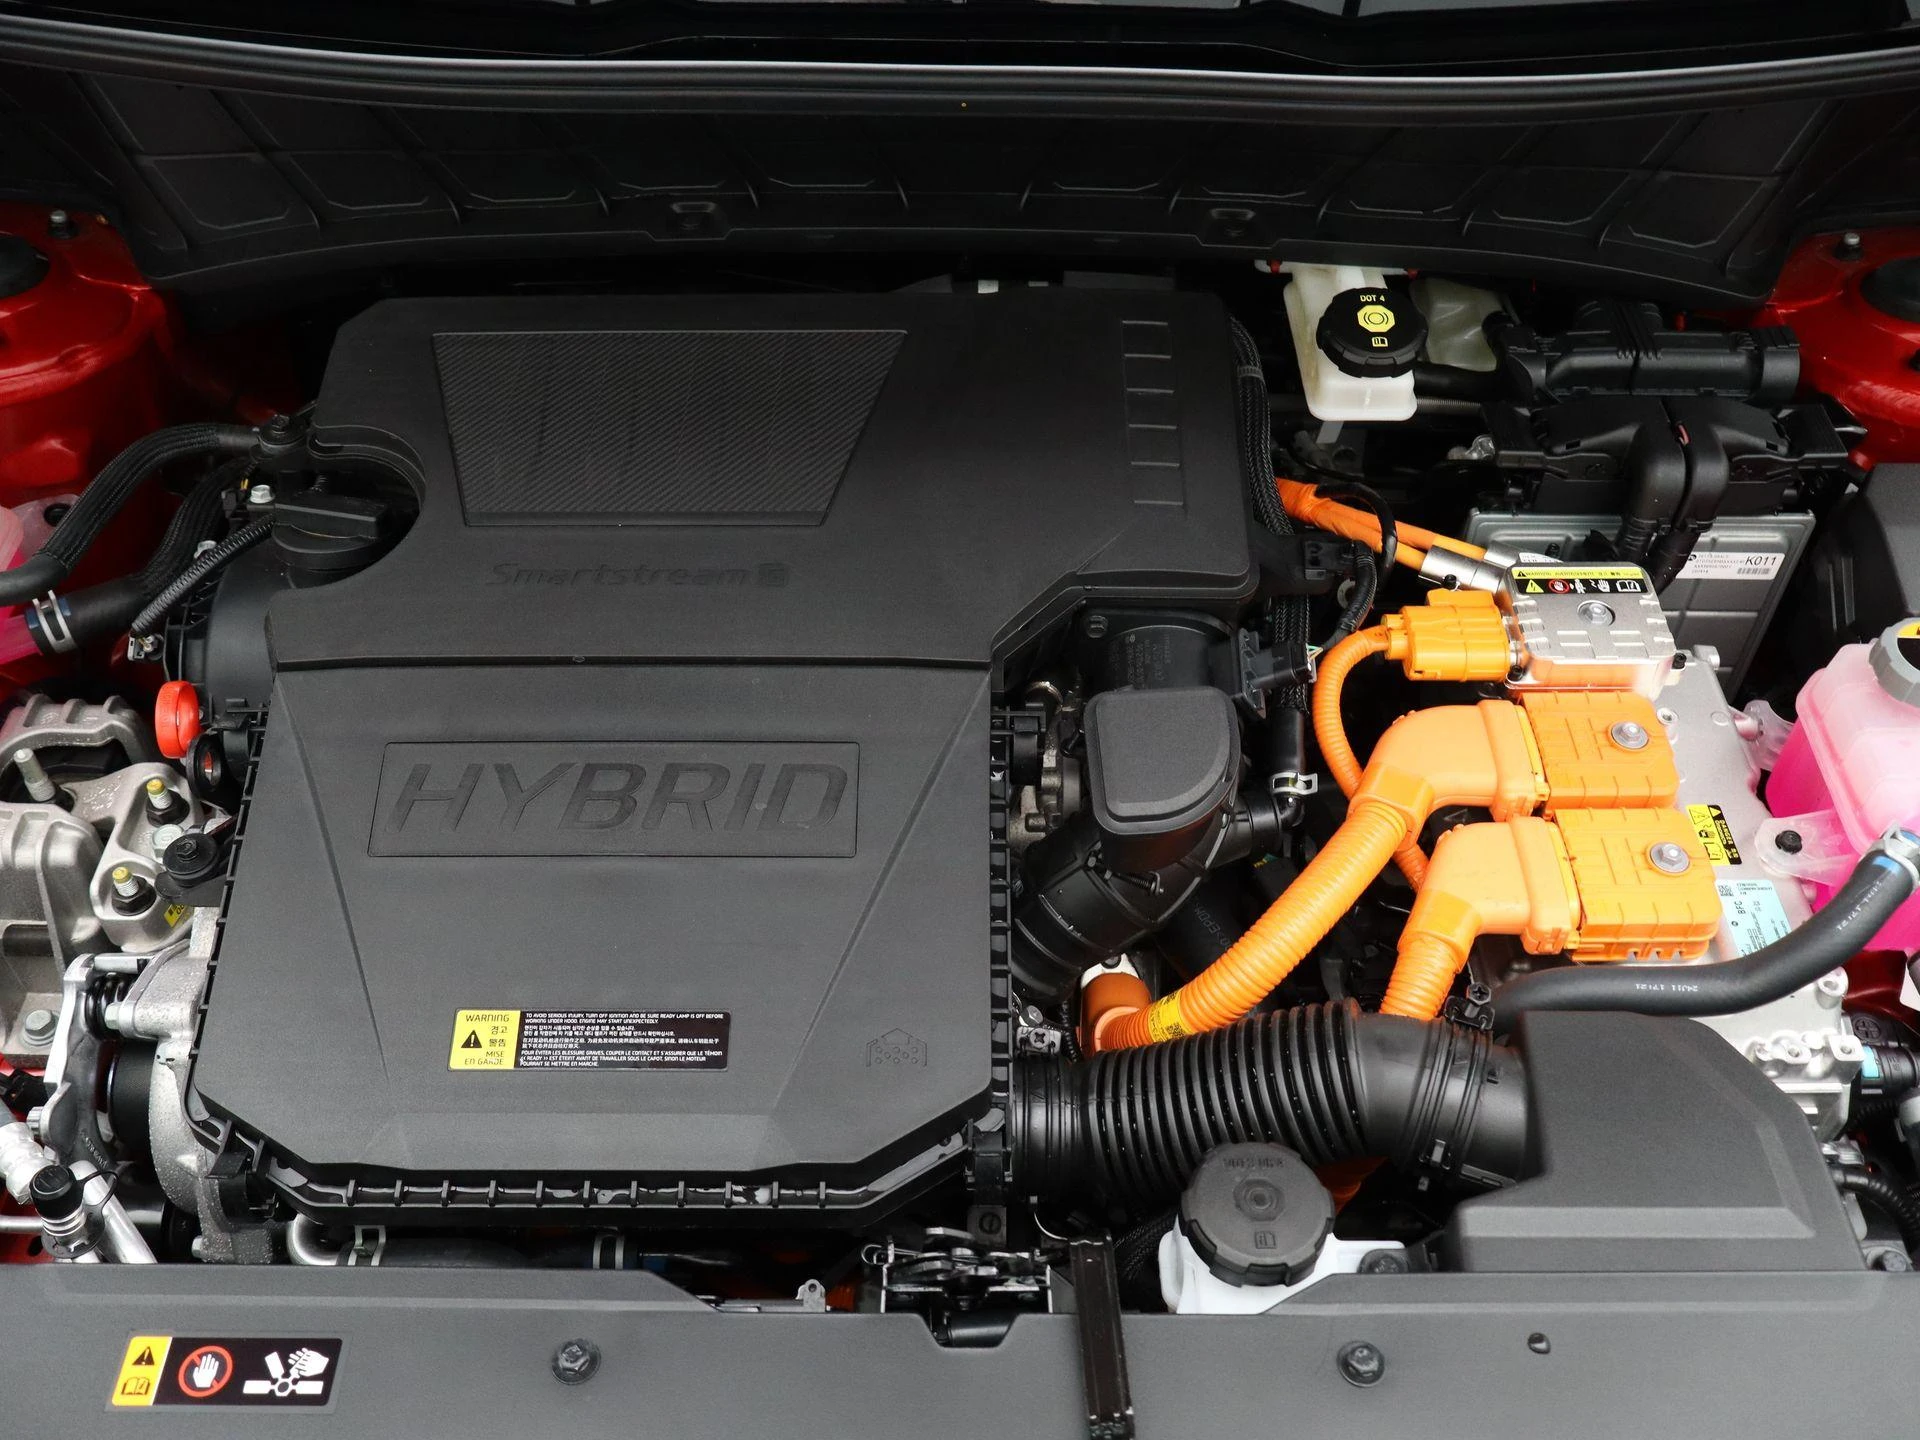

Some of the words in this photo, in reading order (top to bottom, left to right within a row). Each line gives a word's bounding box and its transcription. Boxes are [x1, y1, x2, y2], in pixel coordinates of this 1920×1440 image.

[1360, 294, 1377, 302] DOT
[1379, 294, 1386, 302] 4
[1746, 556, 1777, 566] K011
[486, 562, 752, 586] Smartstream
[385, 762, 848, 831] HYBRID
[465, 1014, 510, 1022] WARNING
[491, 1025, 508, 1035] 경고
